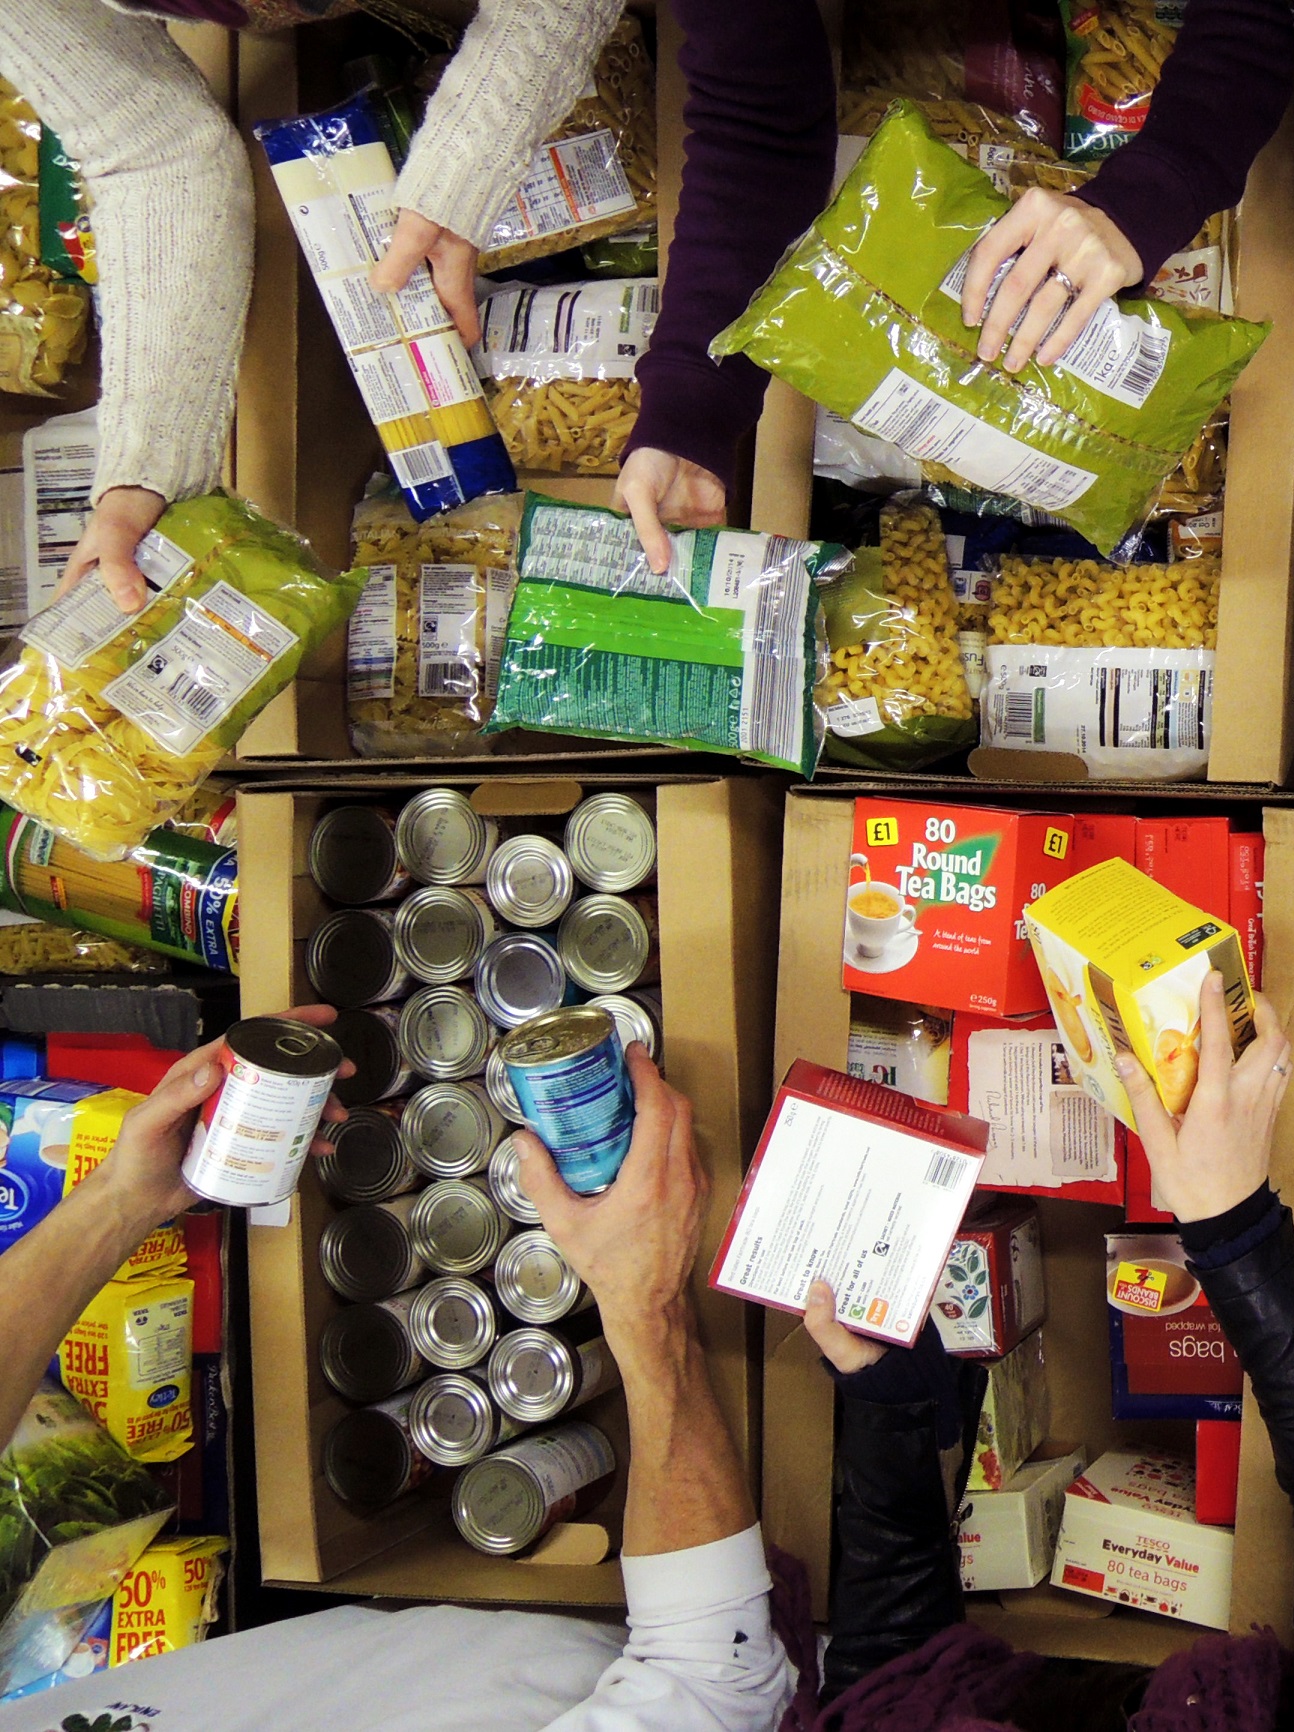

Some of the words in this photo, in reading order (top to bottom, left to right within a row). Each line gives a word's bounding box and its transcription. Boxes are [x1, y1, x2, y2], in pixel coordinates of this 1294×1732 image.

[317, 250, 329, 271] 500g
[169, 644, 189, 662] 500g
[873, 822, 891, 841] £1
[925, 817, 956, 843] 80
[1048, 833, 1062, 853] £1
[912, 842, 982, 876] Round
[206, 875, 230, 915] 50%
[895, 866, 935, 900] Tea
[940, 870, 997, 912] Bags
[1031, 883, 1046, 899] 80
[206, 921, 218, 954] EXTRA
[942, 930, 956, 941] blend
[957, 933, 964, 944] of
[964, 935, 977, 944] teas
[978, 934, 992, 946] from
[1248, 933, 1256, 950] British
[932, 941, 952, 951] around
[953, 943, 962, 953] the
[963, 944, 980, 955] world
[1248, 951, 1257, 960] Tea
[978, 995, 997, 1007] 250g
[1224, 977, 1257, 1048] TWIN
[83, 1144, 95, 1152] bags
[91, 1136, 109, 1144] price
[128, 1252, 162, 1266] EXTRA
[738, 1263, 753, 1286] Great
[747, 1235, 764, 1263] results
[805, 1247, 819, 1268] know
[859, 1249, 868, 1259] us
[855, 1259, 864, 1269] of
[802, 1269, 811, 1278] to
[851, 1269, 860, 1280] all
[793, 1279, 807, 1302] Great
[846, 1280, 856, 1292] for
[1127, 1284, 1159, 1300] BRANDS
[837, 1293, 852, 1315] Great
[1117, 1290, 1157, 1307] DISCOUNT
[98, 1323, 108, 1331] the
[1165, 1322, 1206, 1332] wrapped
[1208, 1323, 1221, 1332] foil
[64, 1339, 109, 1376] FREE
[1169, 1335, 1225, 1363] bags
[67, 1375, 108, 1398] EXTRA
[149, 1389, 177, 1405] Tetley
[127, 1419, 163, 1439] FREE
[1110, 1487, 1150, 1501] Value
[958, 1531, 981, 1543] alue
[1137, 1535, 1170, 1550] TESCO
[1102, 1538, 1162, 1564] Everyday
[1165, 1554, 1200, 1574] Value
[1107, 1560, 1125, 1574] 80
[1128, 1567, 1149, 1581] tea
[1153, 1572, 1188, 1592] bags
[119, 1569, 166, 1609] 50%
[117, 1609, 166, 1628] EXTRA
[116, 1630, 166, 1663] FREE
